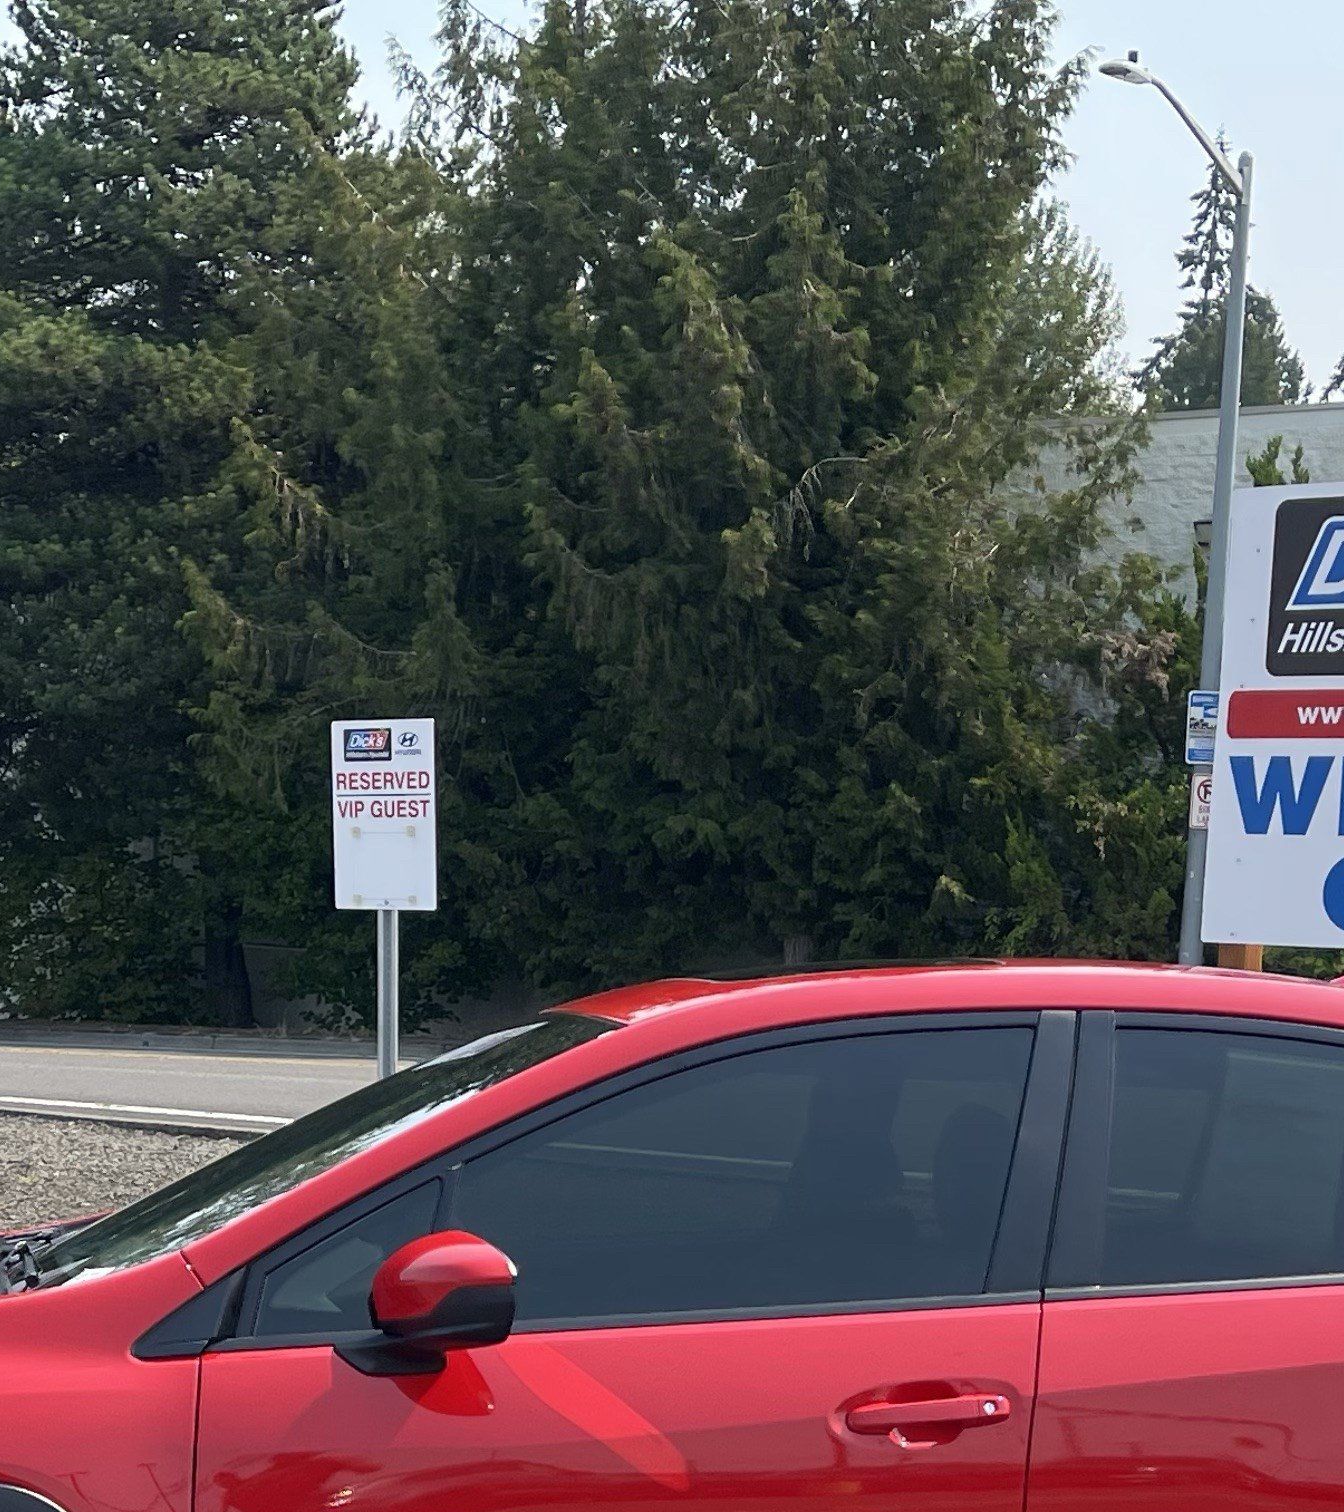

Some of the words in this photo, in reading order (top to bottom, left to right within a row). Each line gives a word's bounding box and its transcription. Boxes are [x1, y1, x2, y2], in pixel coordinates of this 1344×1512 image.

[336, 770, 431, 790] RESERVED
[337, 800, 365, 819] VIP
[370, 799, 431, 818] GUEST
